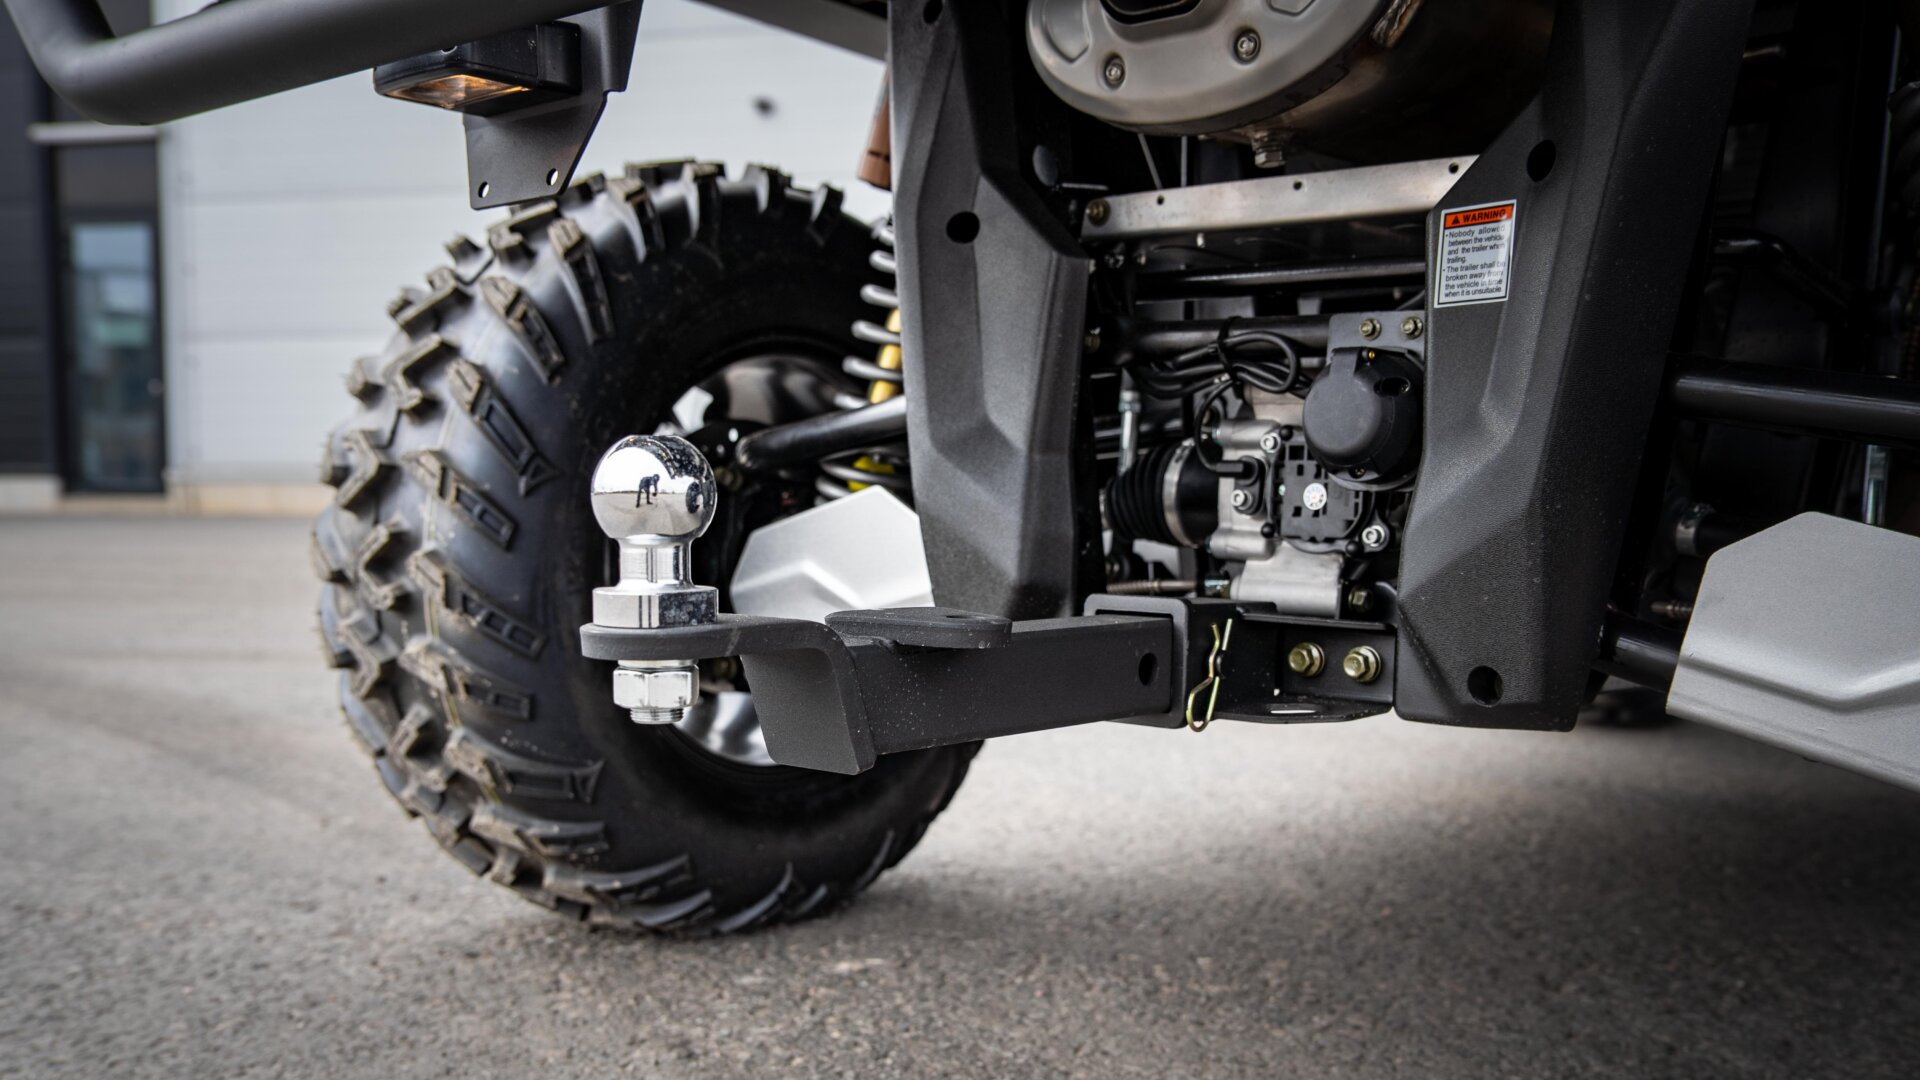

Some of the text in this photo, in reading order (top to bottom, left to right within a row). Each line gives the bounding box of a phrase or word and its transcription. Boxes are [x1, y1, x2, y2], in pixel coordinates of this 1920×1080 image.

[1463, 209, 1506, 222] WARNING
[1449, 229, 1475, 238] Nobody
[1449, 238, 1472, 247] between
[1472, 244, 1488, 252] trailer
[1447, 265, 1458, 273] The
[1460, 263, 1479, 271] trailer
[1480, 261, 1496, 269] shall
[1445, 274, 1468, 282] broken
[1469, 272, 1486, 280] away
[1457, 280, 1479, 288] vehicle
